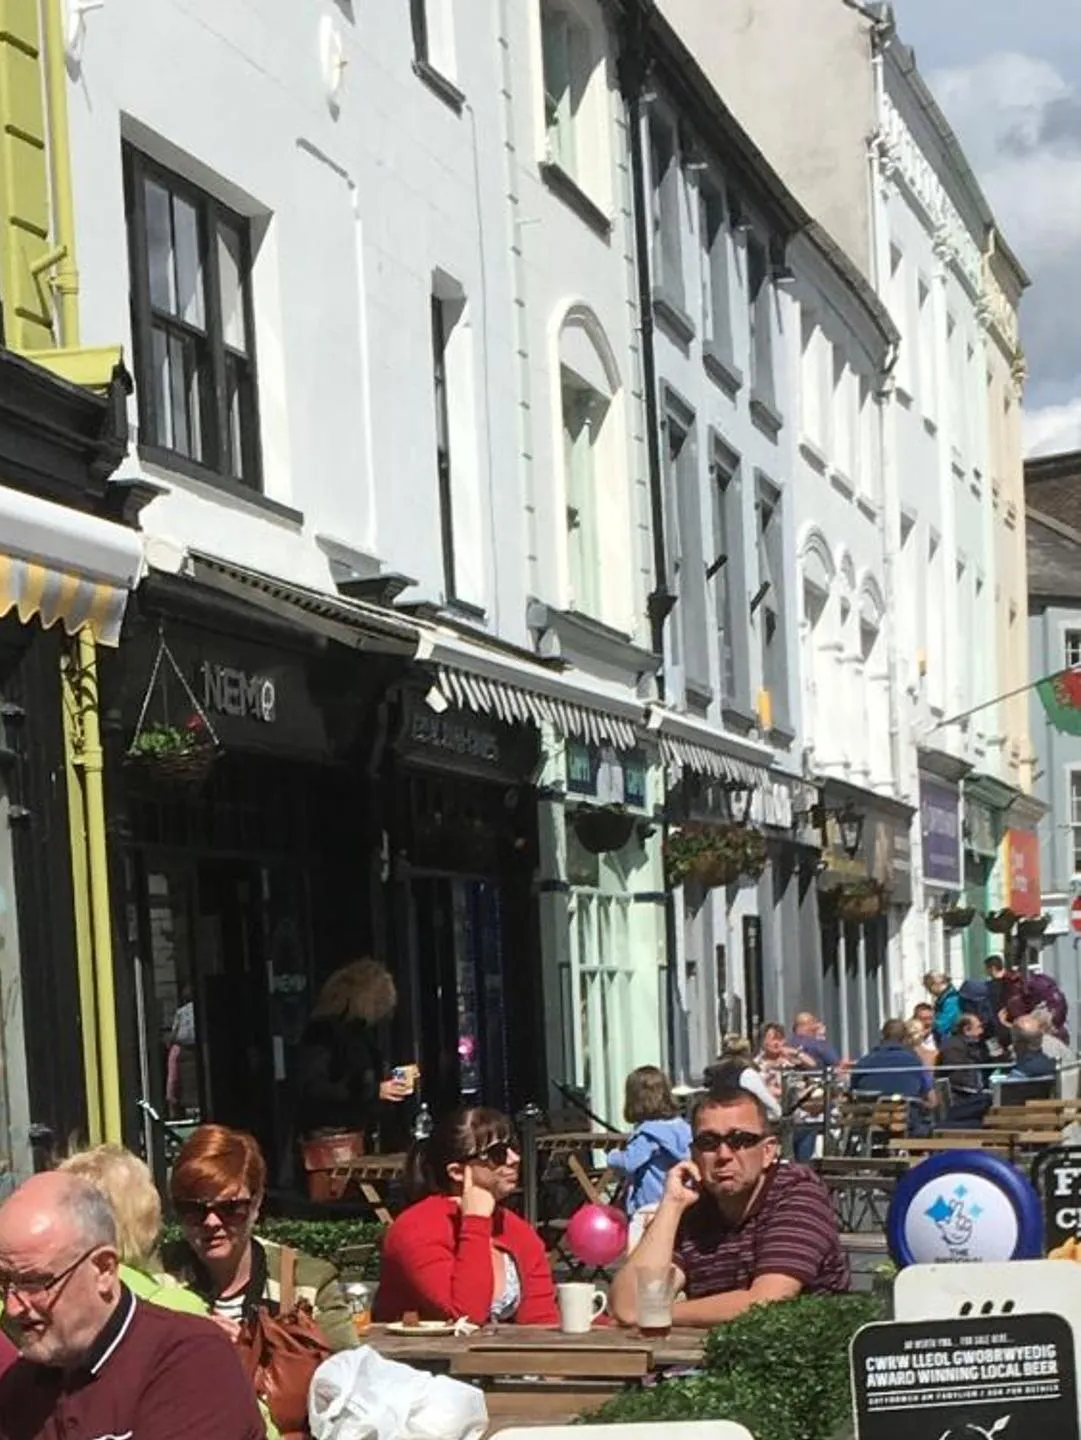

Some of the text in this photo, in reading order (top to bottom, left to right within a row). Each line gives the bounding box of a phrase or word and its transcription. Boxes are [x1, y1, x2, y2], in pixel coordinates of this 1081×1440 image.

[201, 661, 275, 723] NEMO
[865, 1355, 909, 1372] CWRW
[912, 1352, 951, 1368] LLEOL
[867, 1360, 1058, 1388] AWARD WINNING LOCAL BEER
